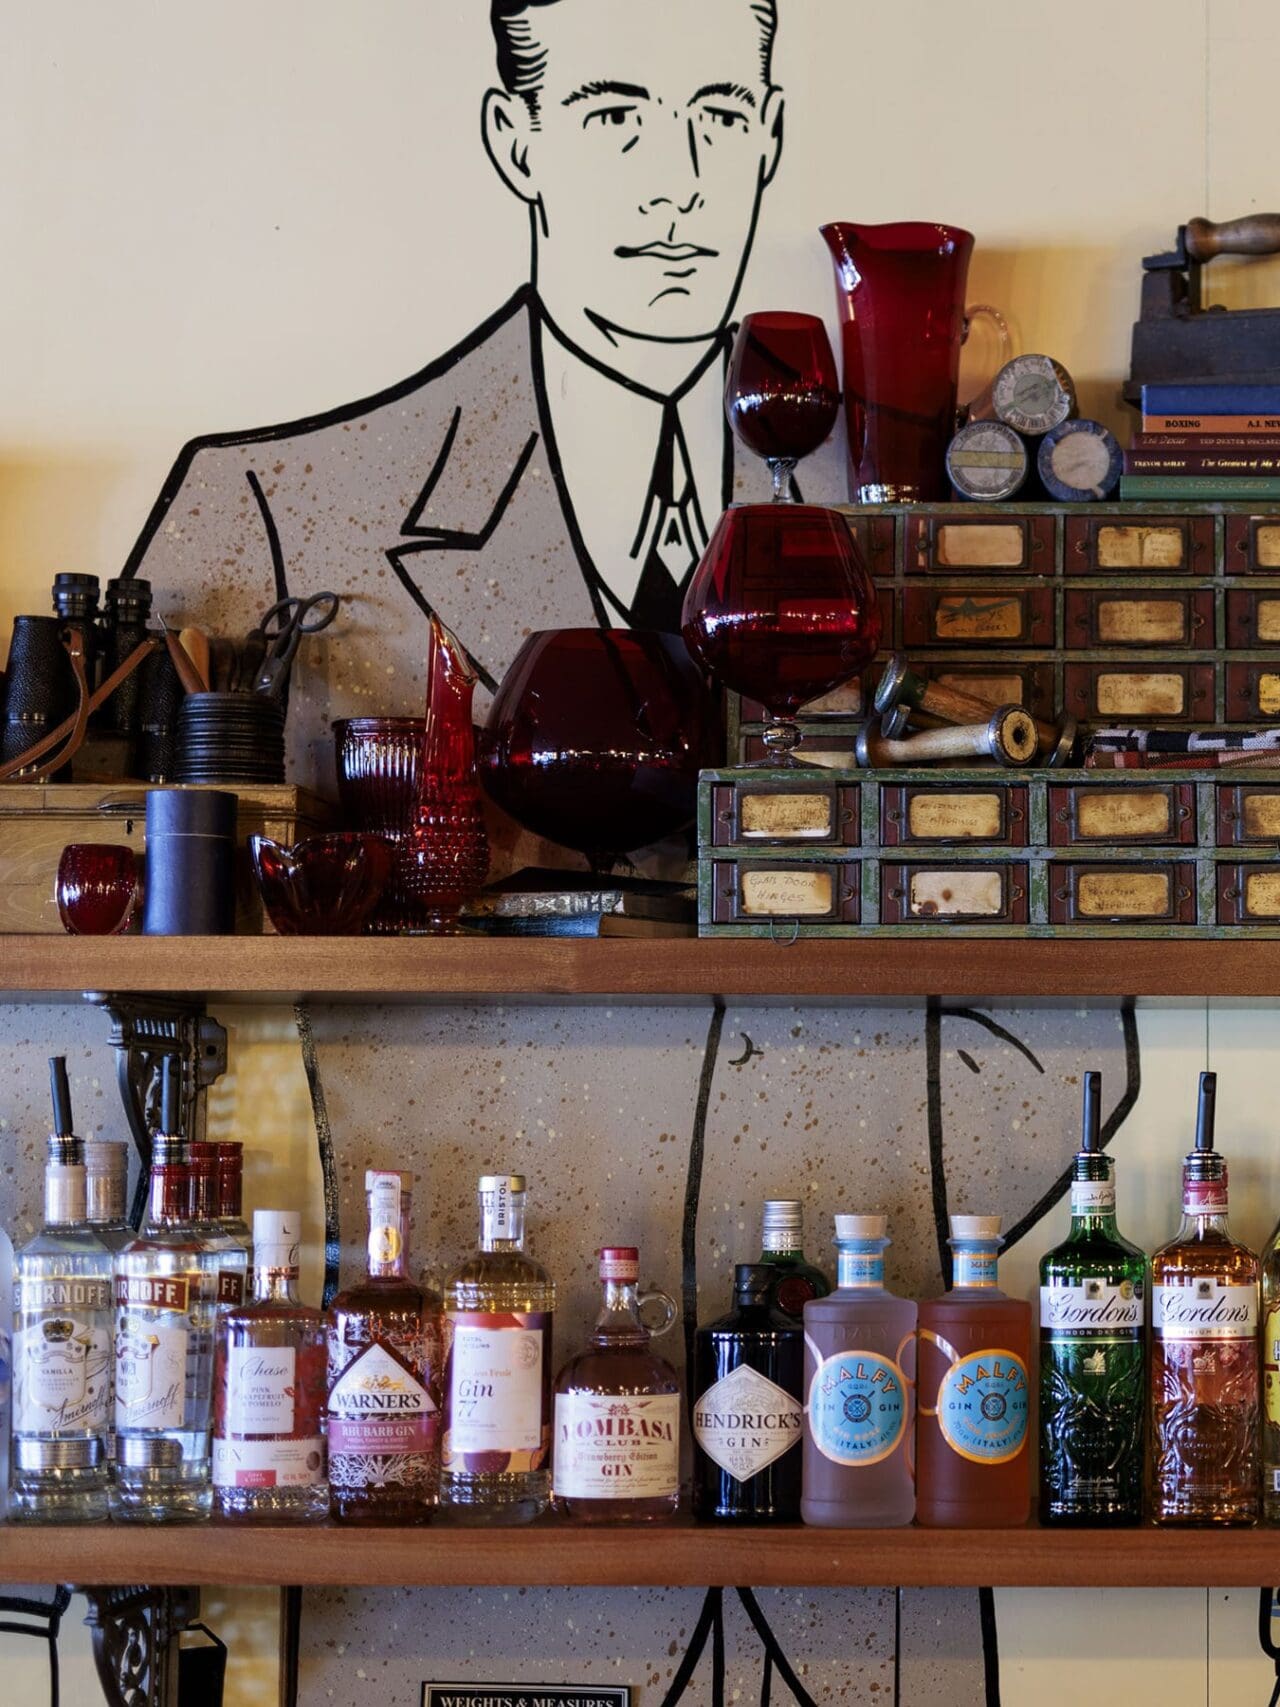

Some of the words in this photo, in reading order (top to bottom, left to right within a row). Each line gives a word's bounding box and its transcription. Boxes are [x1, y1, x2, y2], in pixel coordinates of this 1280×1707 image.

[1165, 420, 1200, 428] BOXING
[498, 1181, 506, 1225] BRISTOL
[1048, 1294, 1138, 1324] Gordon's
[1160, 1294, 1250, 1323] Gordon's
[240, 1357, 288, 1377] Chase
[822, 1363, 897, 1396] MALFY
[954, 1362, 1025, 1395] MALFY
[459, 1379, 494, 1397] Gin
[336, 1394, 421, 1408] WARNER'S
[459, 1400, 477, 1416] 77
[696, 1413, 800, 1429] HENDRICK'S
[342, 1426, 393, 1436] RHUBARB
[396, 1426, 415, 1436] GIN
[727, 1438, 761, 1447] GIN
[602, 1464, 632, 1476] GIN
[440, 1696, 512, 1707] WEIGHTS
[516, 1697, 528, 1707] &
